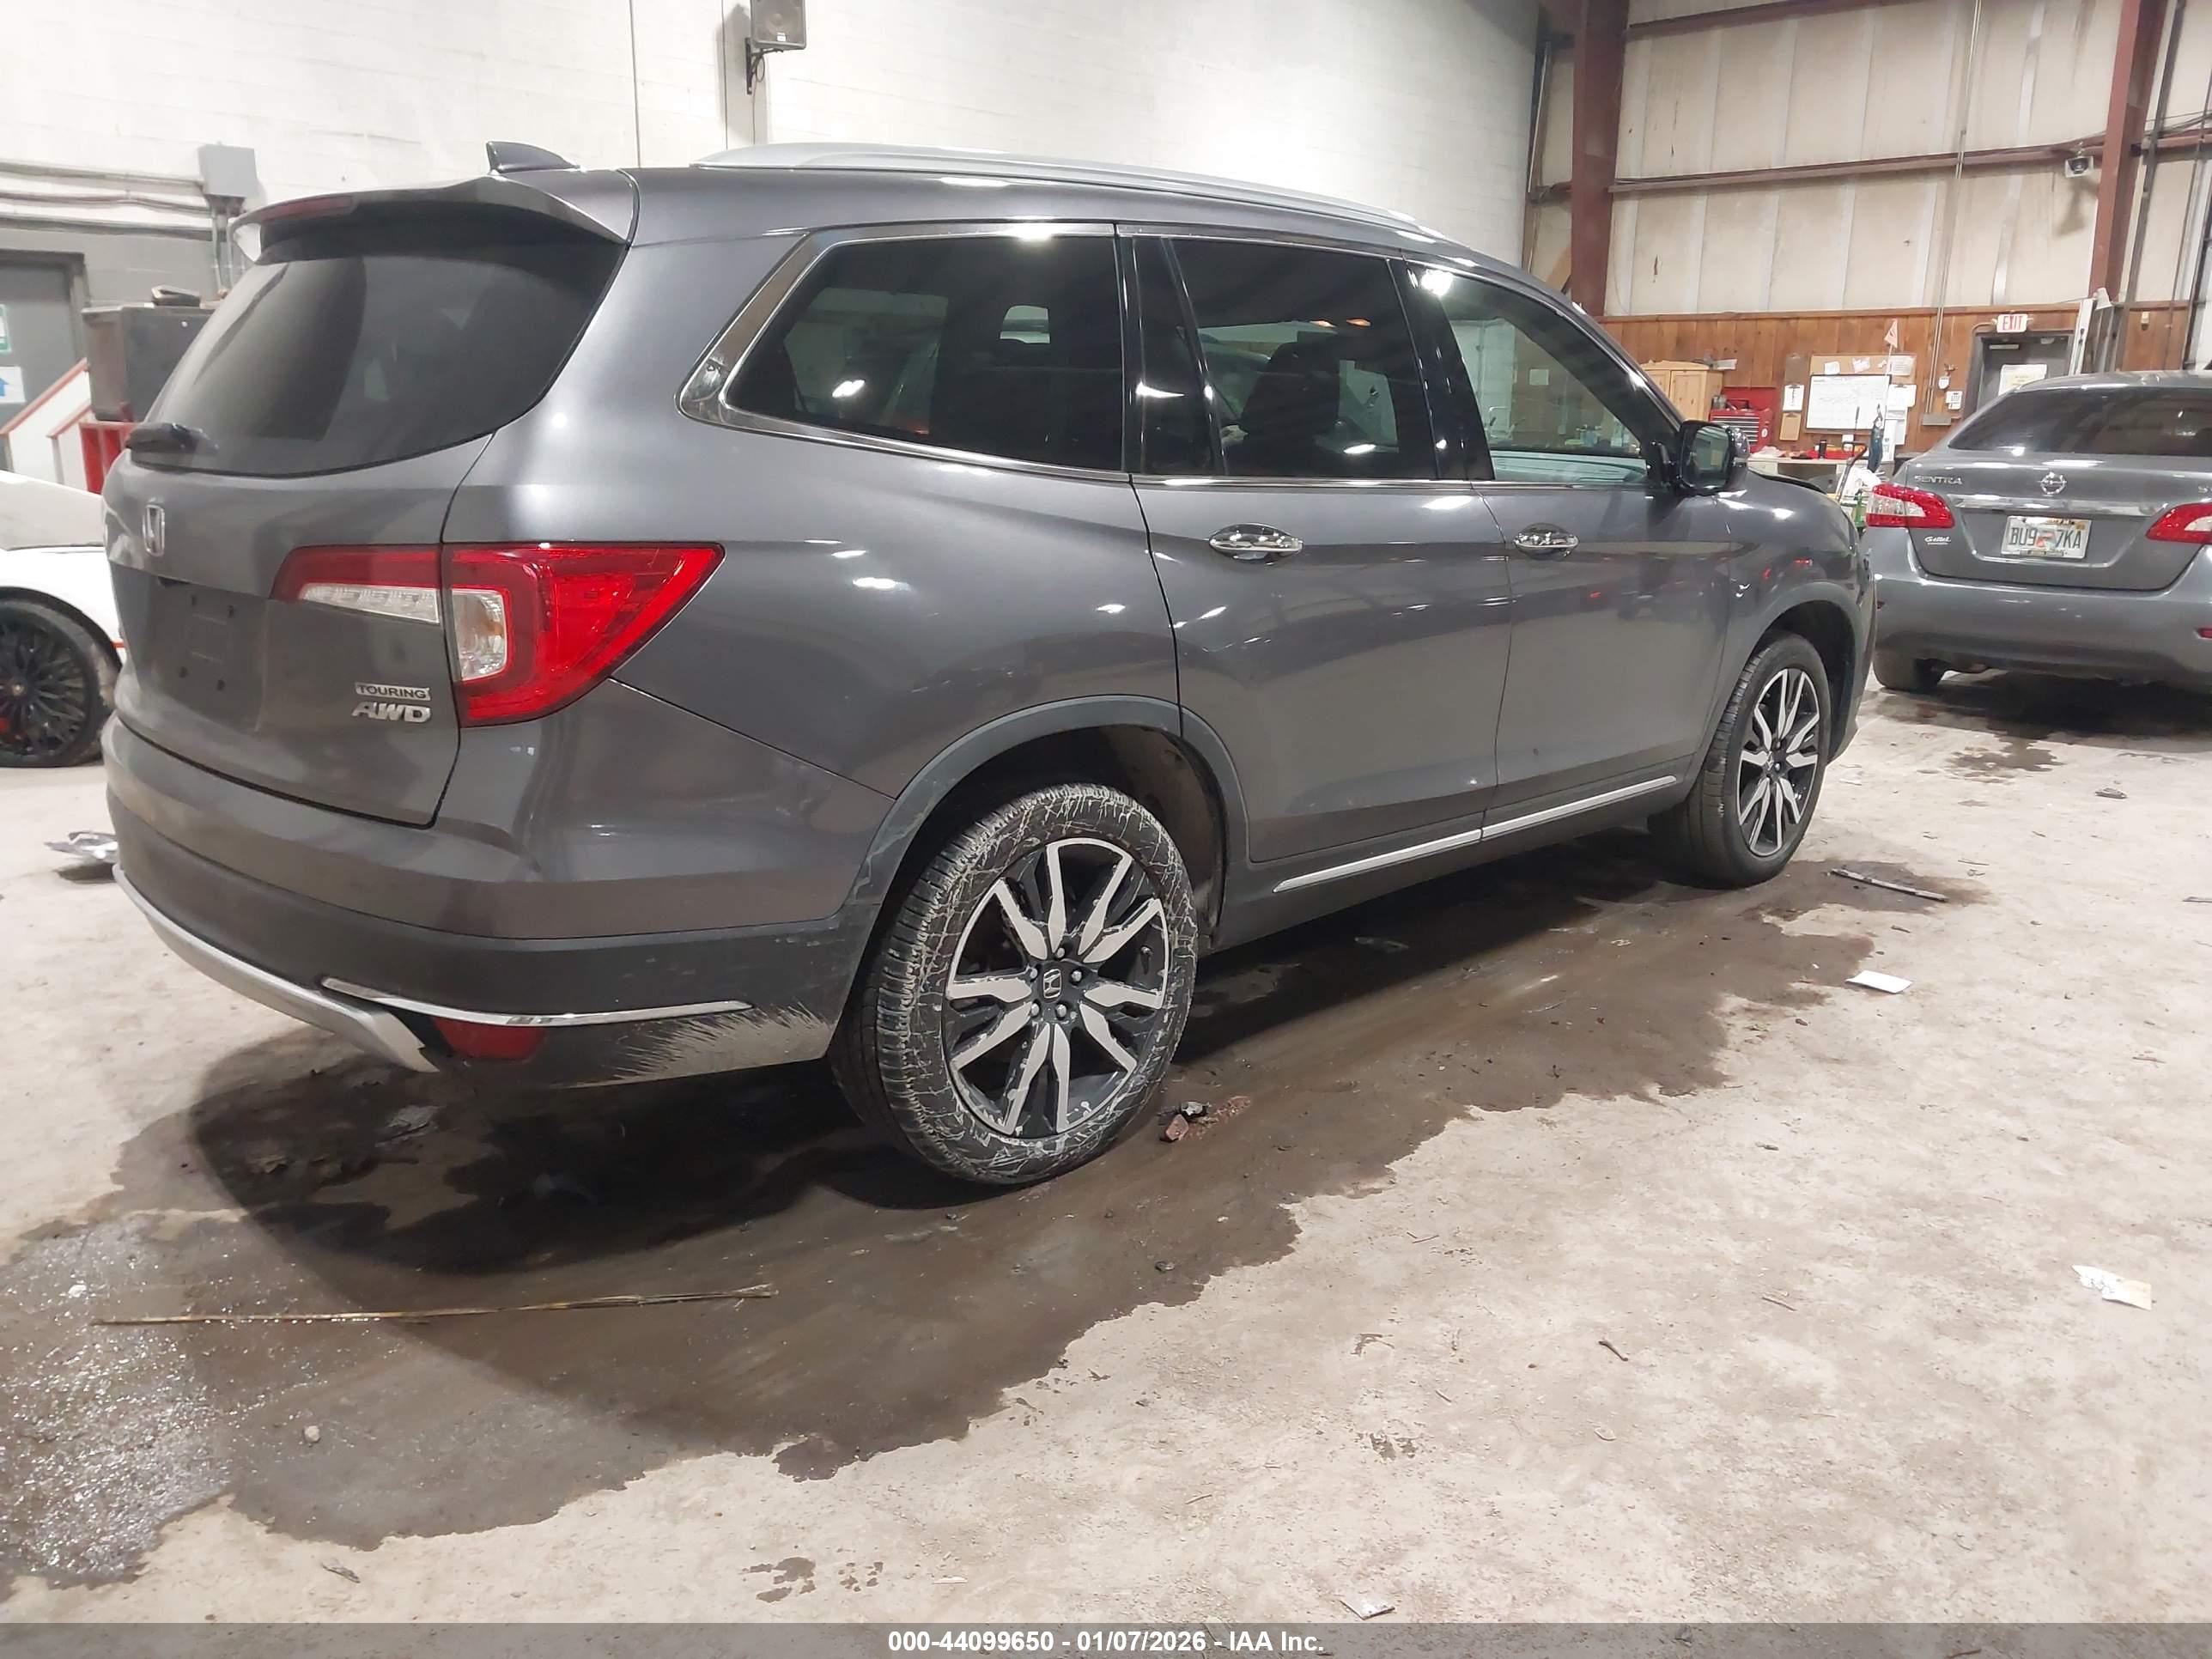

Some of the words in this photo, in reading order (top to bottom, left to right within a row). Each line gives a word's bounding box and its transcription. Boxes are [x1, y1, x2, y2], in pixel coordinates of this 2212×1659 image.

[2002, 315, 2023, 331] EXIT
[1914, 475, 1963, 485] SENTRA
[356, 684, 428, 700] TOURING
[351, 702, 431, 723] AWD
